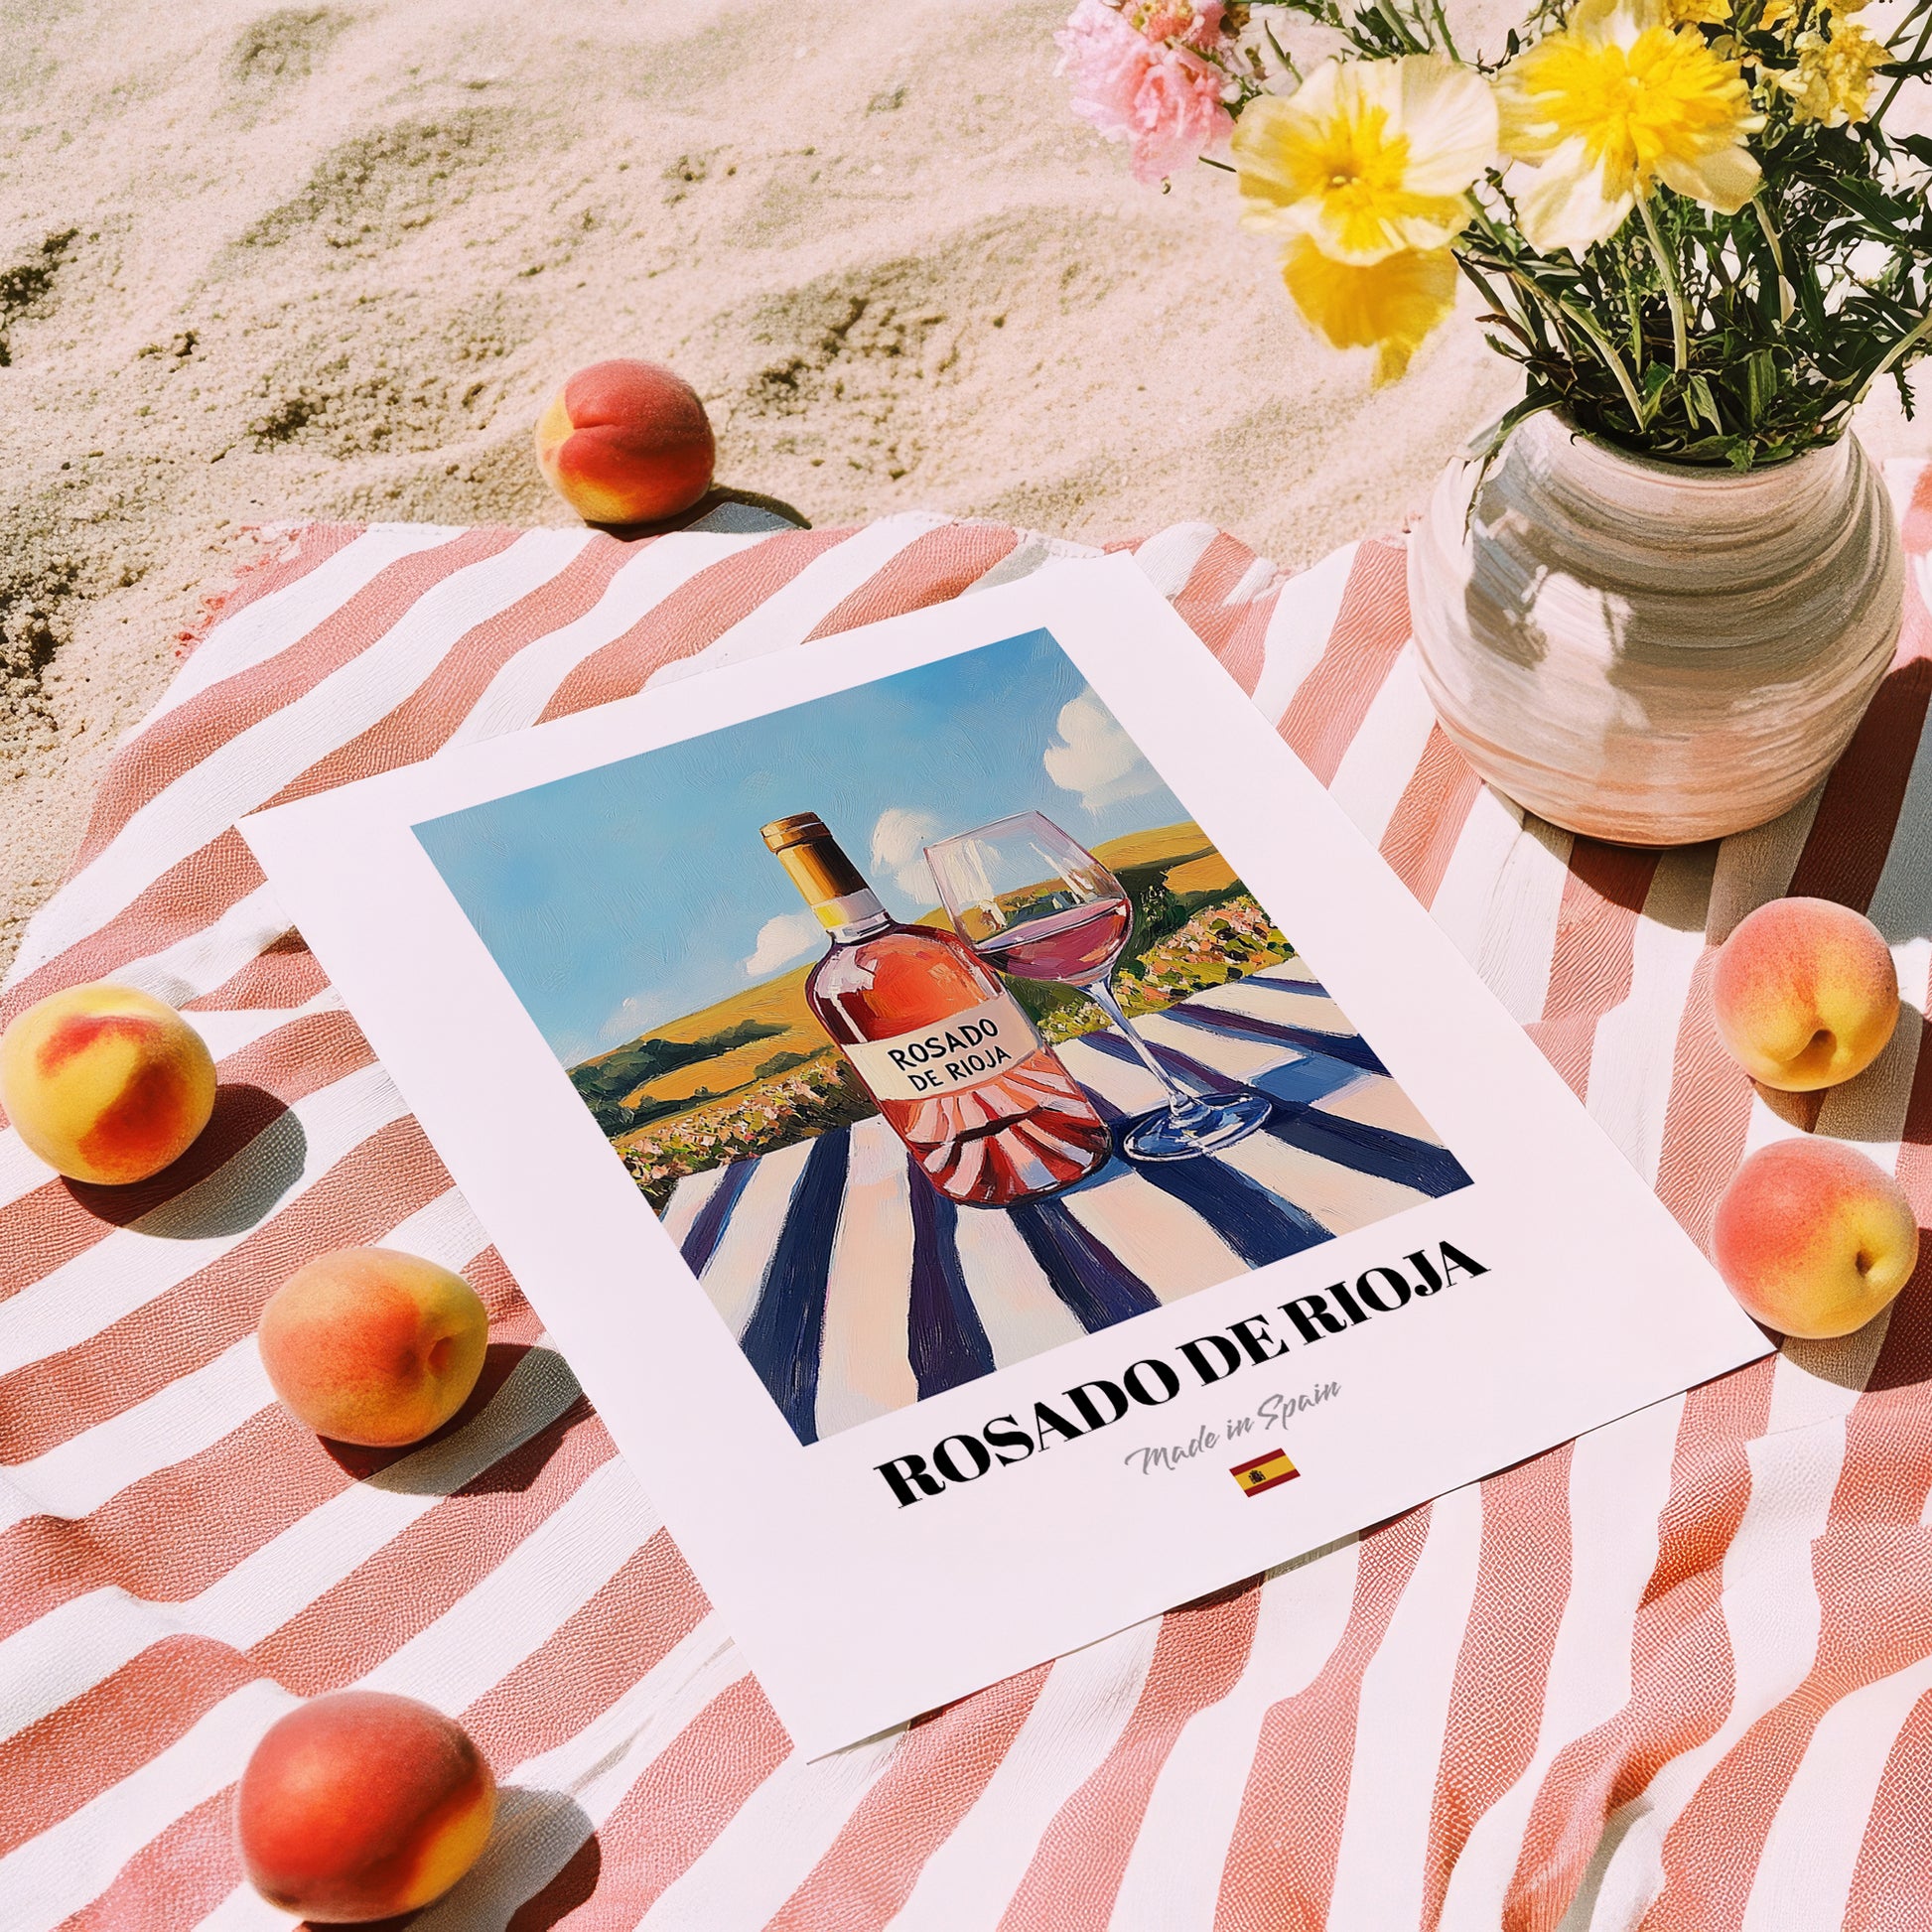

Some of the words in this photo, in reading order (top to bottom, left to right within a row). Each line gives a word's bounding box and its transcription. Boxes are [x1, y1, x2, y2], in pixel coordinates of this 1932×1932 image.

[888, 1019, 999, 1071] ROSADO
[907, 1069, 943, 1091] DE
[944, 1045, 1012, 1081] RIOJA
[873, 1358, 1180, 1509] ROSADO
[1175, 1313, 1292, 1387] DE
[1277, 1240, 1492, 1346] RIOJA
[1124, 1425, 1220, 1475] Made
[1225, 1417, 1254, 1441] in
[1256, 1381, 1342, 1431] Spain
